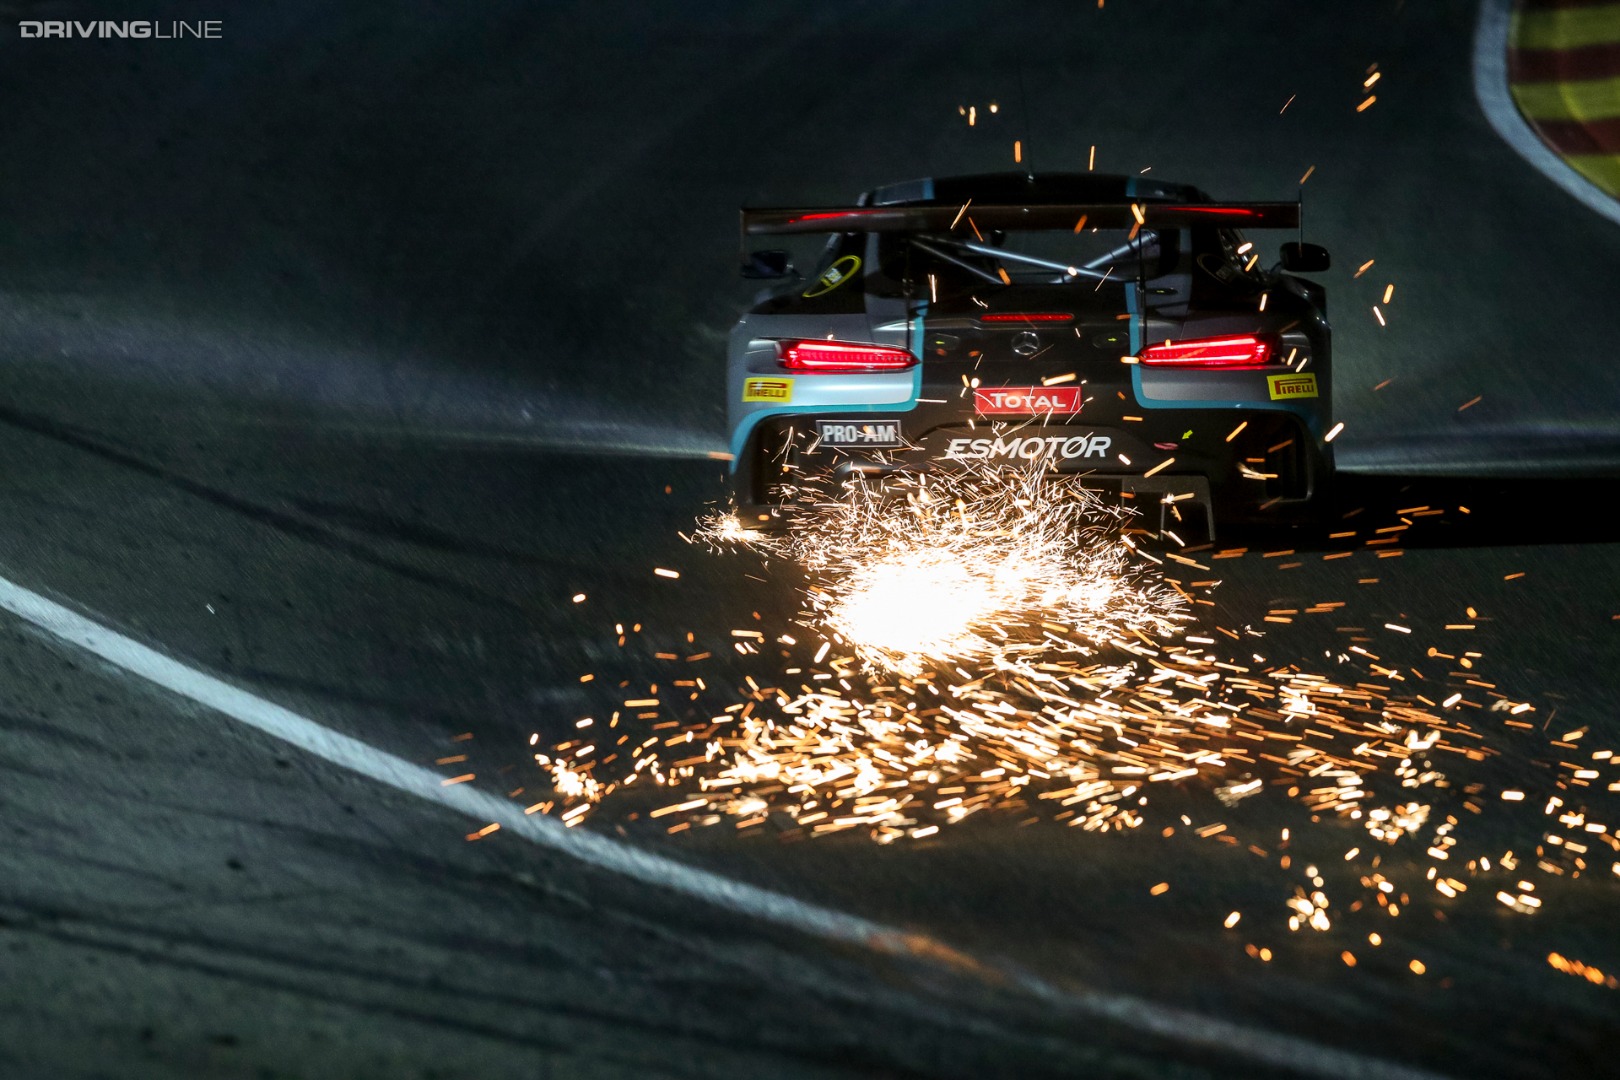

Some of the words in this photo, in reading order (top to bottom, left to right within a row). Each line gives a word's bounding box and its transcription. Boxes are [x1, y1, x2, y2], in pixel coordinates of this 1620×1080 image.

[746, 381, 788, 398] PIRELLI
[1274, 378, 1315, 395] PIRELLI
[990, 392, 1067, 409] TOTAL
[822, 424, 896, 443] PRO-AM
[945, 436, 1112, 460] ESMOTOR
